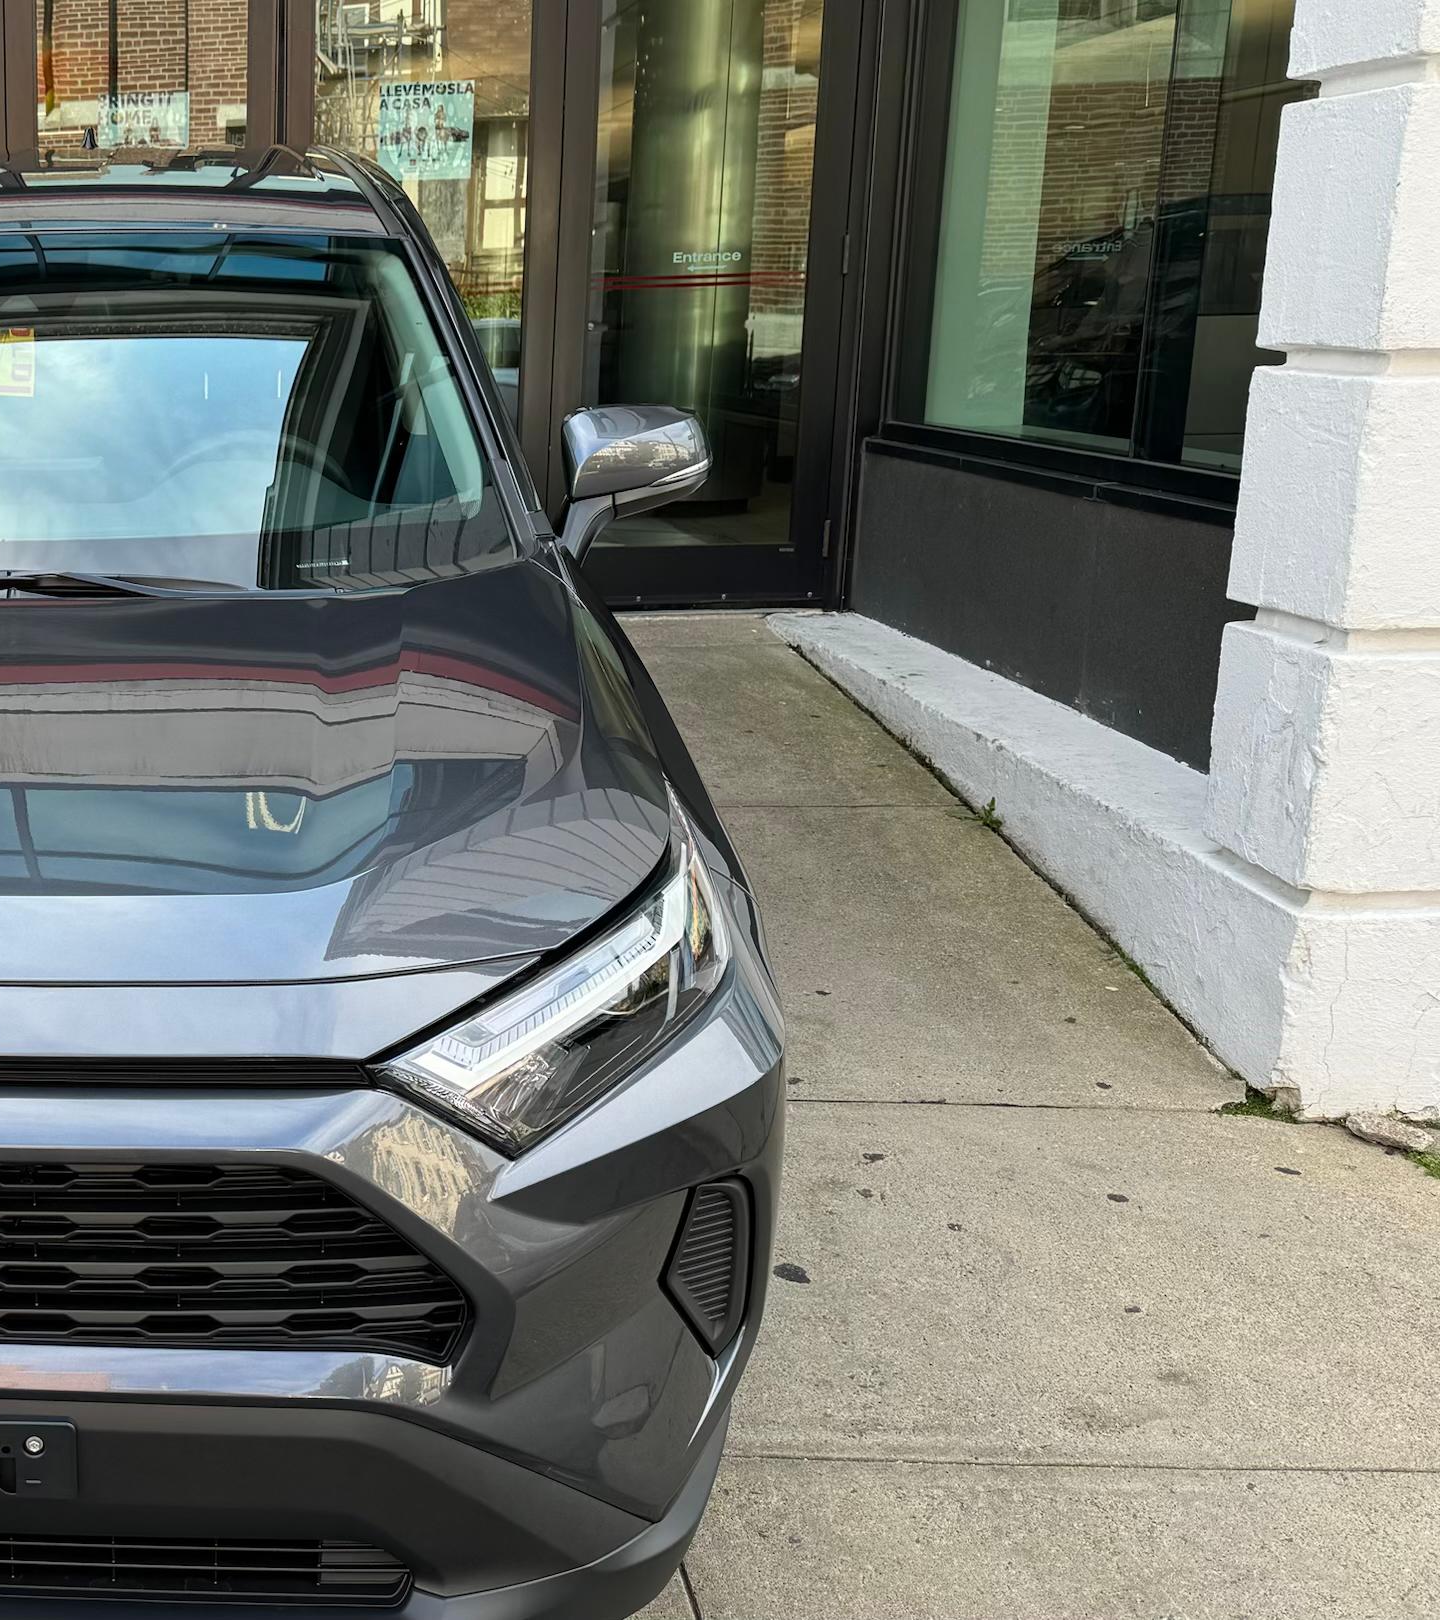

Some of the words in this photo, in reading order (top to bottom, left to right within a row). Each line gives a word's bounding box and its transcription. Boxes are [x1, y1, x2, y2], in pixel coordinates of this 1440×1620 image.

[380, 99, 389, 111] A
[392, 98, 432, 111] CASA
[672, 251, 742, 263] Entrance
